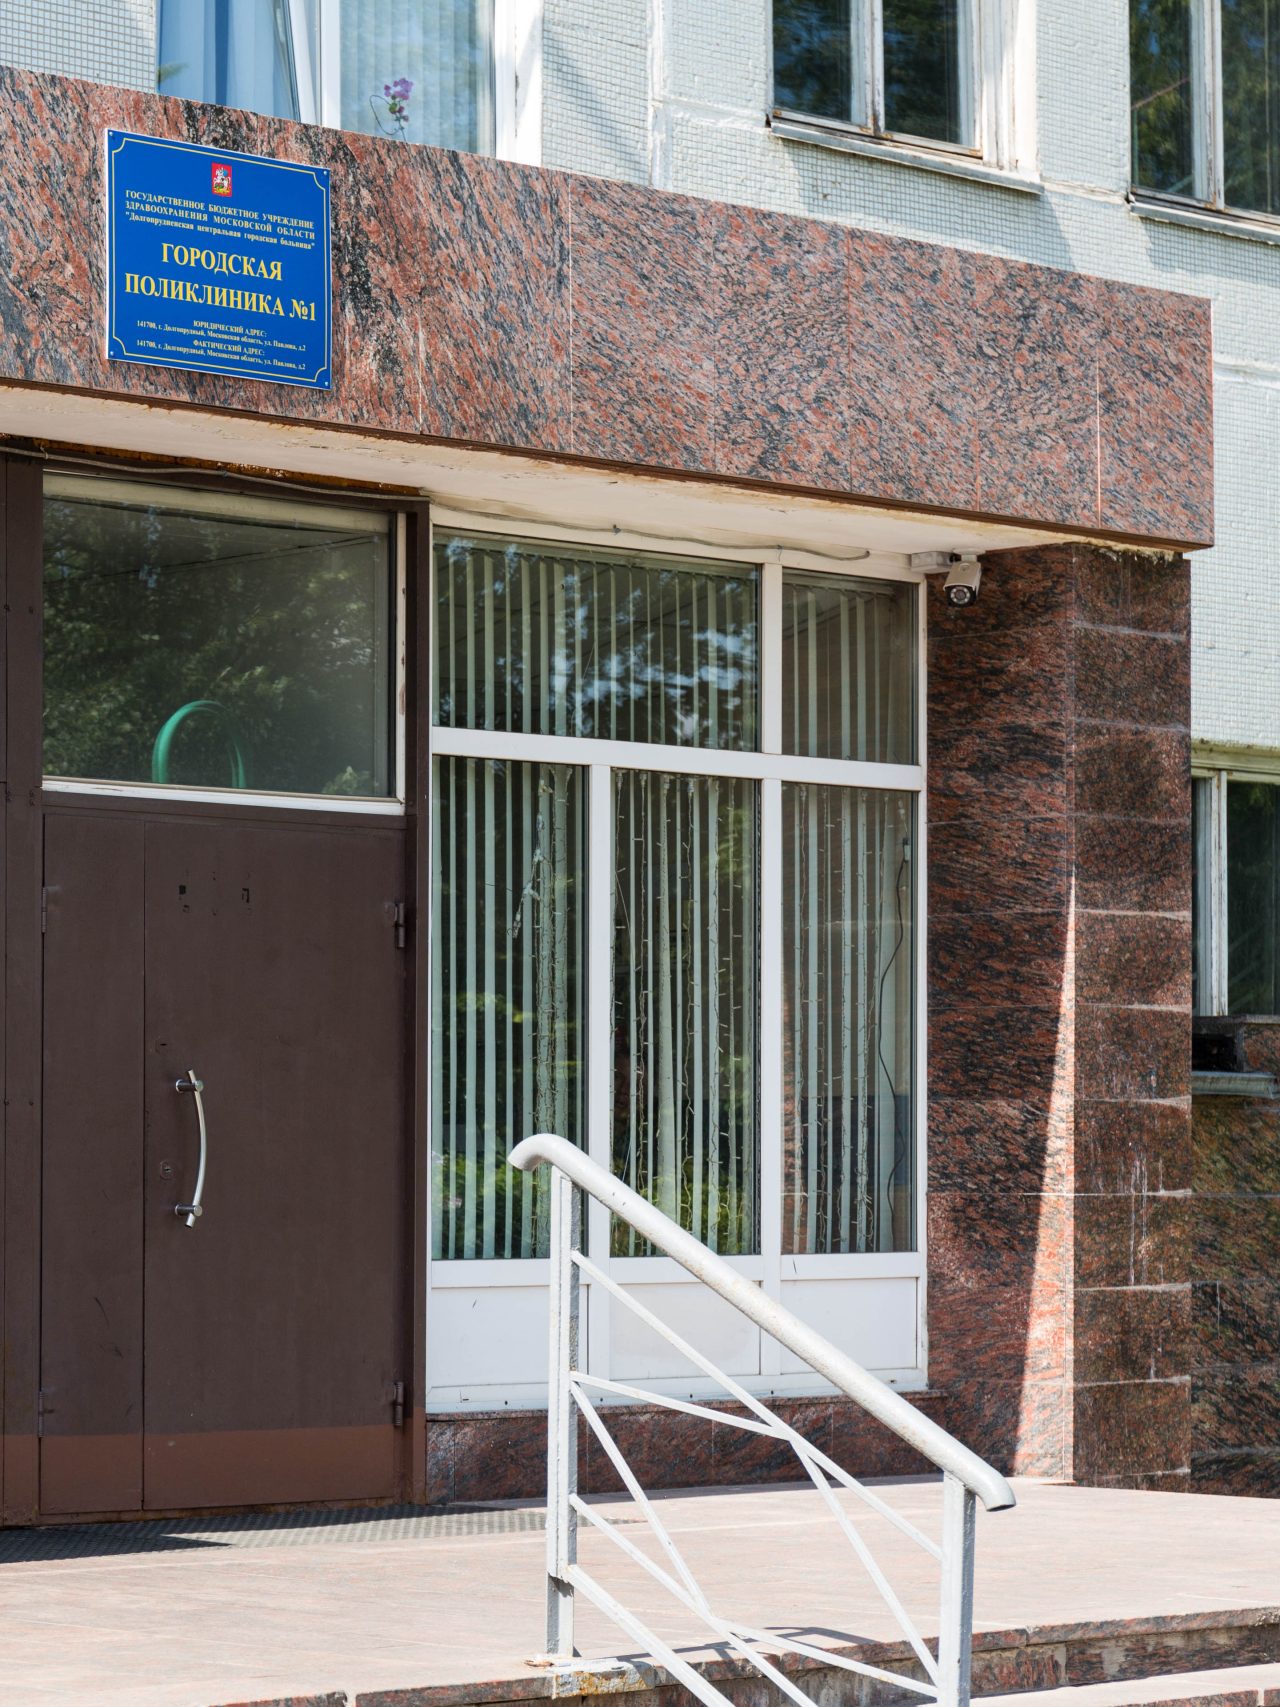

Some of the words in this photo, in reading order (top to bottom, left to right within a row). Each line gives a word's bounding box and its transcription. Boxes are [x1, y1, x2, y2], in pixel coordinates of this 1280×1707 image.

[126, 190, 206, 210] ГОСУДАРСТВЕННОЕ
[208, 204, 259, 220] БЮДЖЕТНОЕ
[262, 213, 314, 229] УЧРЕЖДЕНИЕ
[126, 200, 208, 222] ЗДРАВООХРАНЕНИЯ
[214, 215, 272, 232] МОСКОВСКОЙ
[277, 226, 315, 240] ОБЛАСТИ
[197, 225, 241, 237] центральная
[244, 232, 277, 243] городская
[280, 238, 315, 249] больница"
[162, 243, 282, 281] ГОРОДСКАЯ
[124, 272, 285, 316] ПОЛИКЛИНИКА
[289, 298, 316, 321] №1
[164, 324, 206, 336] Долгопрудный,
[208, 330, 240, 341] Московская
[241, 336, 263, 346] область,
[194, 320, 244, 334] ЮРИДИЧЕСКИЙ
[245, 328, 267, 337] АДРЕС:
[163, 343, 206, 355] Долгопрудный,
[207, 350, 240, 360] Московская
[241, 355, 263, 364] область,
[193, 339, 241, 352] ФАКТИЧЕСКИЙ
[243, 345, 265, 356] АДРЕС:
